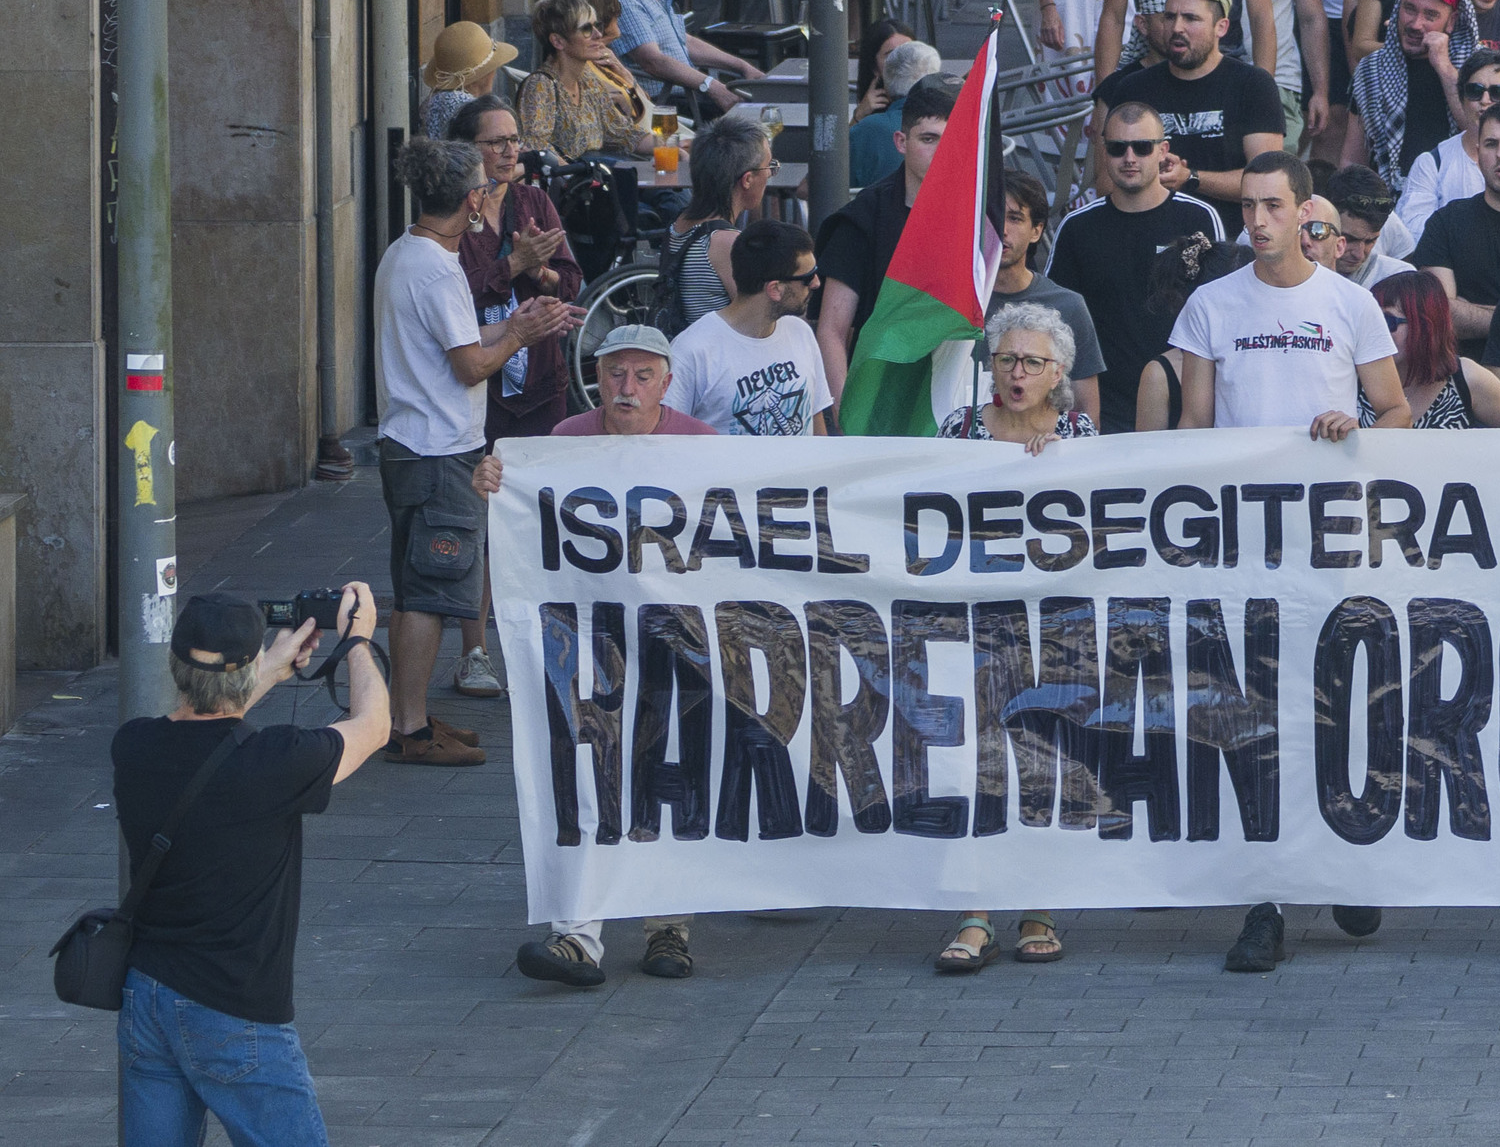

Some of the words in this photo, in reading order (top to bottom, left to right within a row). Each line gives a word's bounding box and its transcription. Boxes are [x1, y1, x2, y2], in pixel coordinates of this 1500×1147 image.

[1234, 334, 1288, 352] PALESTINA
[538, 486, 870, 574] ISRAEL
[903, 479, 1497, 576] DESEGITERA
[538, 596, 1280, 847] HARREMAN
